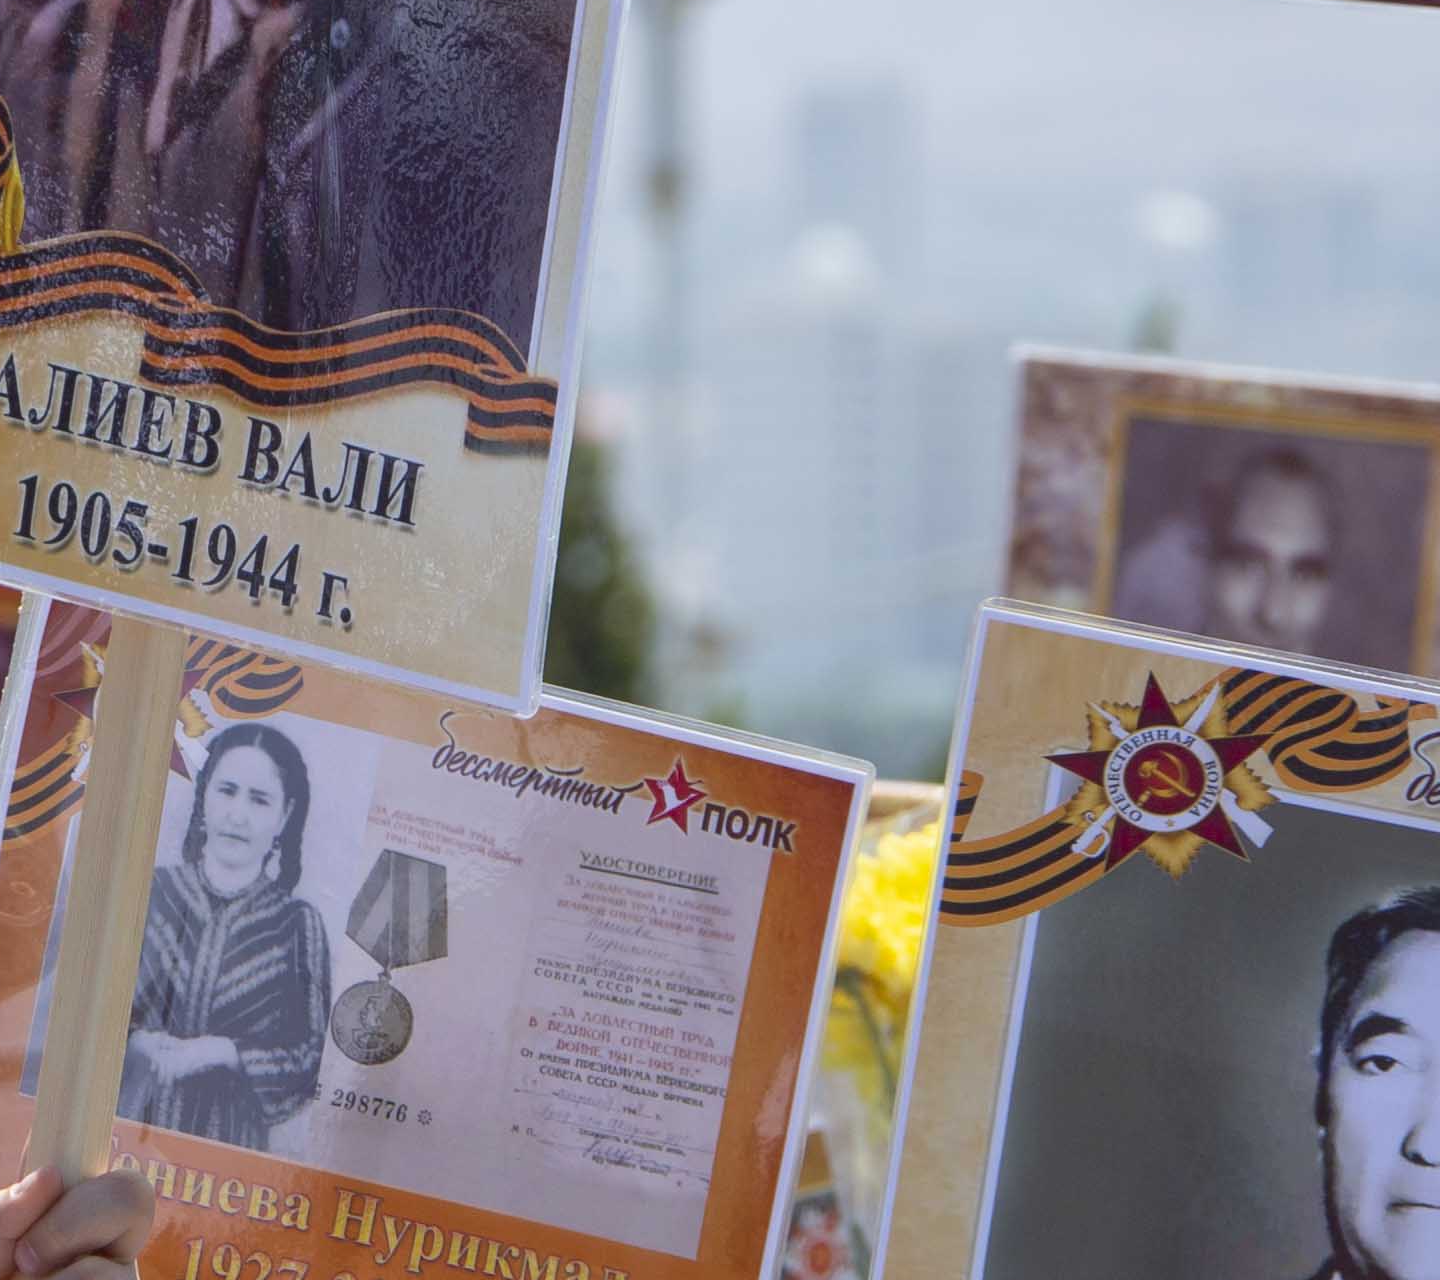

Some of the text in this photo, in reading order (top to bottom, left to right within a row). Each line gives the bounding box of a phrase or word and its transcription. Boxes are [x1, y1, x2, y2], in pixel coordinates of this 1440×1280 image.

[237, 415, 424, 526] ВАЛИ
[13, 474, 351, 623] 1905-1944 г.
[1107, 729, 1197, 822] ОТЕЧЕСТВЕННАЯ
[700, 802, 797, 851] ПОЛК
[579, 850, 719, 889] УДОСТОВЕРЕНИЕ
[533, 967, 633, 994] СОВЕТА СССР
[681, 1032, 714, 1048] ТРУД
[587, 1076, 616, 1089] СССР
[331, 1089, 408, 1123] 298776
